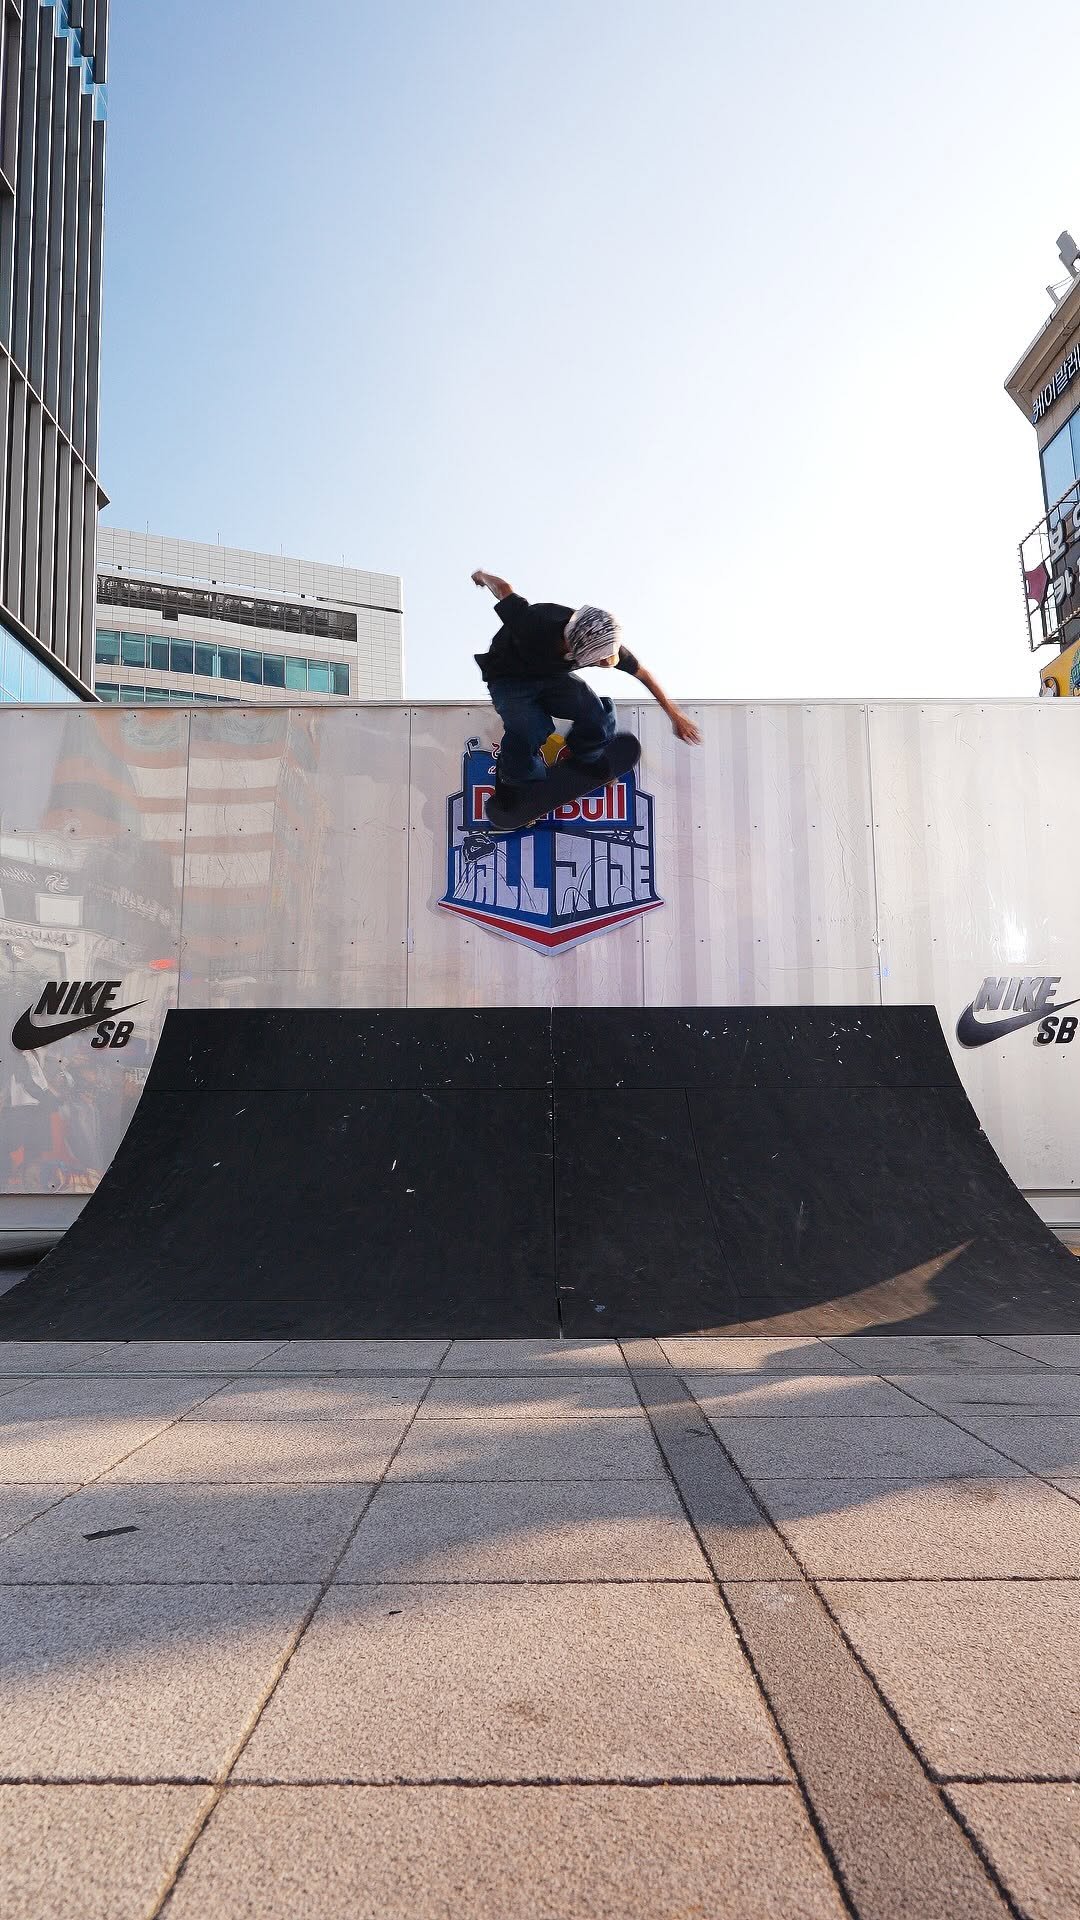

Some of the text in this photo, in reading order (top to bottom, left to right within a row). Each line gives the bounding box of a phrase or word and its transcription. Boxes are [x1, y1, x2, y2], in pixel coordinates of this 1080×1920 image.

[34, 981, 122, 1014] NIKE
[973, 977, 1061, 1012] NIKE
[90, 1021, 134, 1048] SB
[1035, 1016, 1079, 1045] SB
